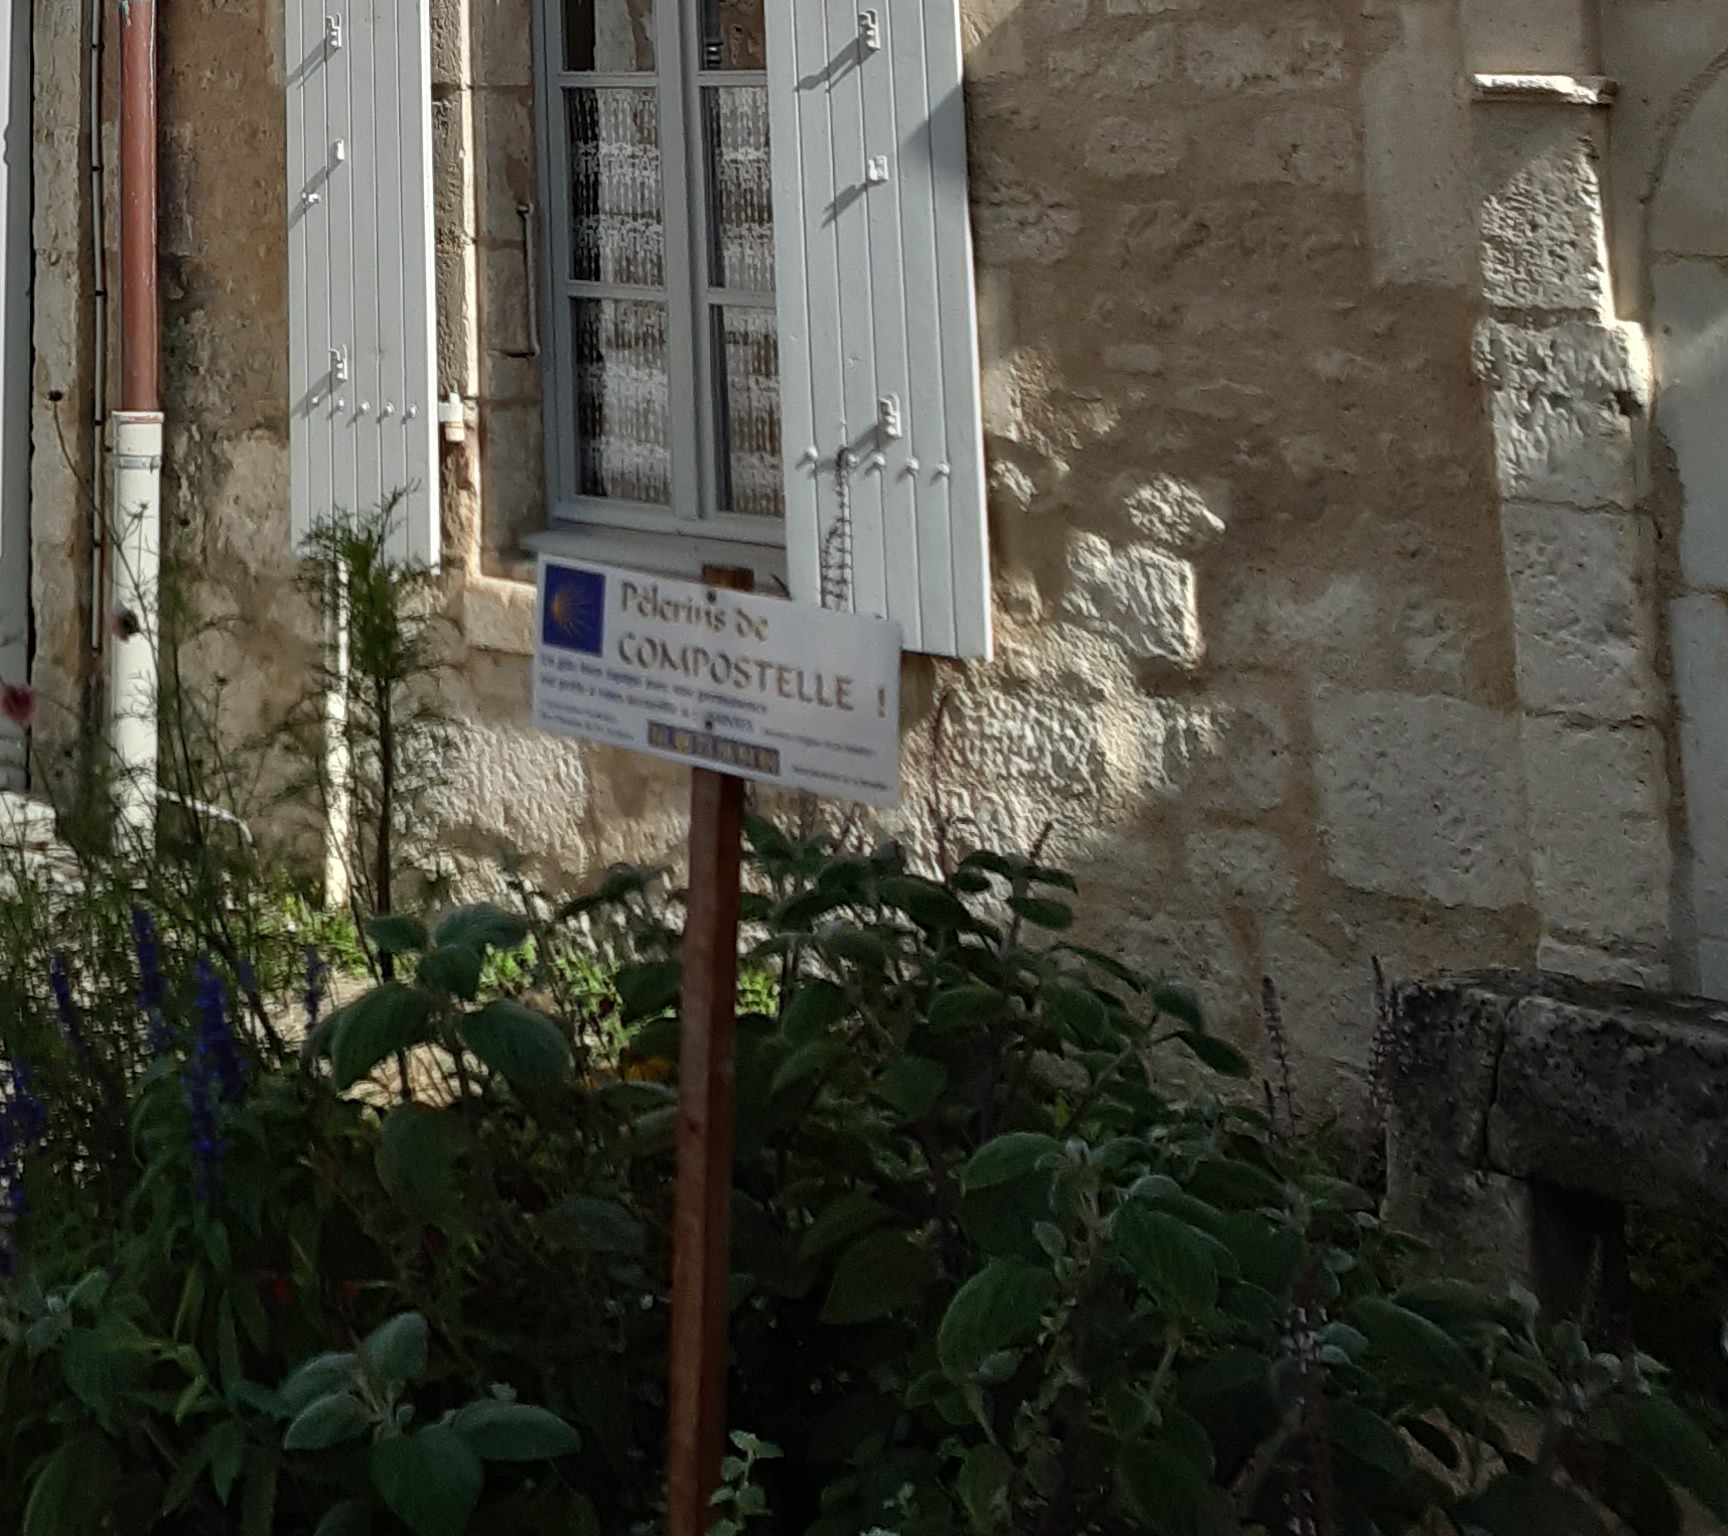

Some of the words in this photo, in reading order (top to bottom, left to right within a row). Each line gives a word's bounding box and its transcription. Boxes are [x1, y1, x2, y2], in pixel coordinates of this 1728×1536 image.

[735, 607, 769, 642] de
[618, 632, 854, 712] COMPOSTELLE
[876, 686, 886, 718] !
